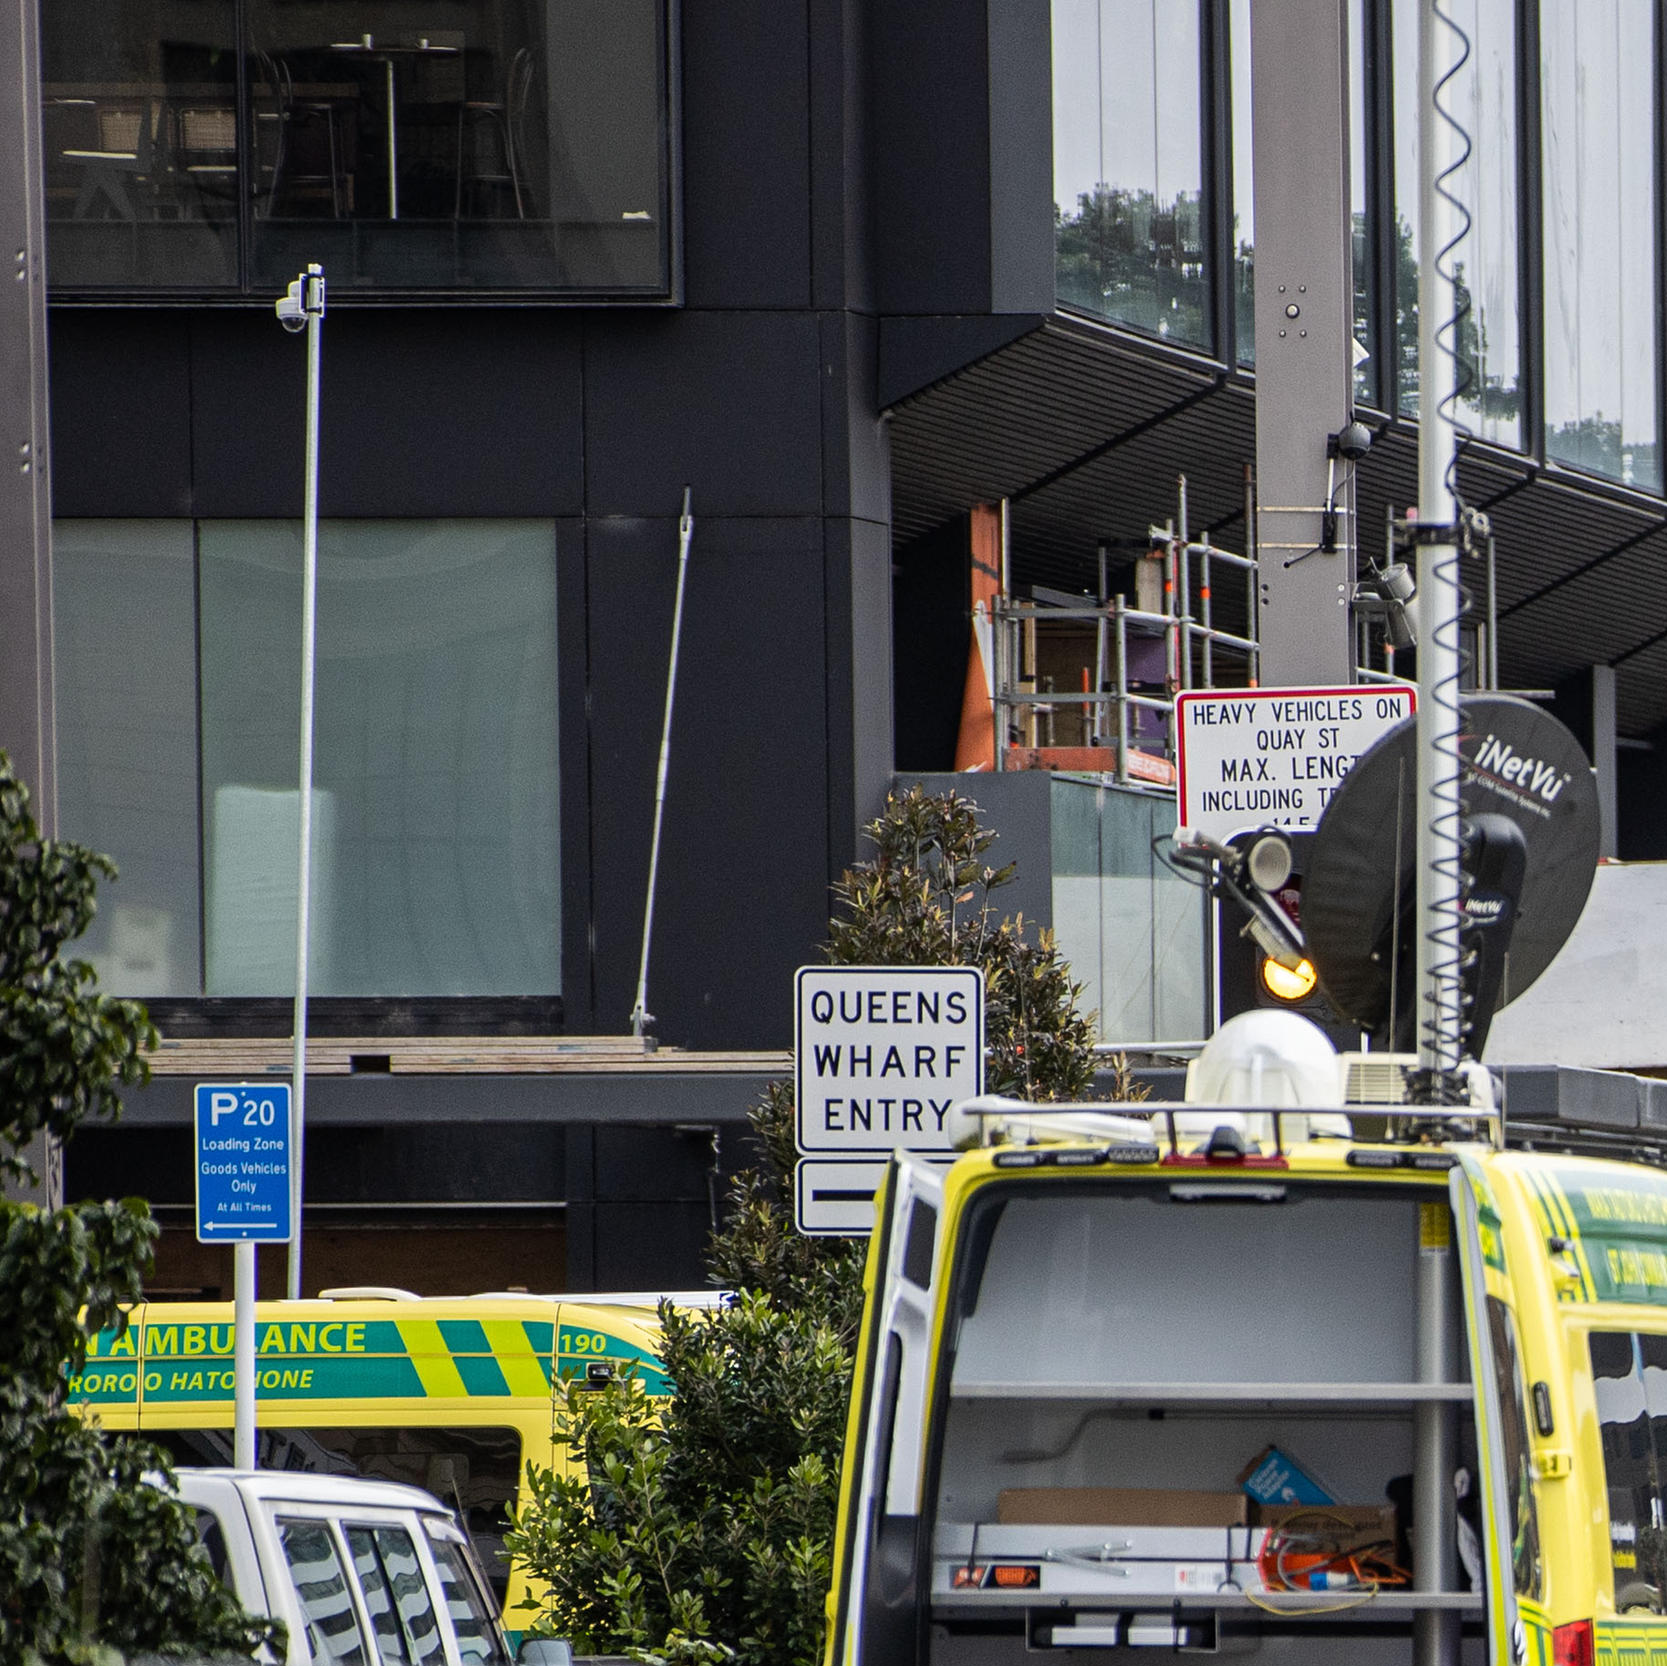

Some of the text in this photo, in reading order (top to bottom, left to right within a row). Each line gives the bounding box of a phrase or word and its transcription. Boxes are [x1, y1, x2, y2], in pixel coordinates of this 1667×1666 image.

[1193, 698, 1401, 725] HEAVY VEHICLES ON
[1256, 728, 1340, 751] QUAY ST
[1221, 755, 1361, 782] MAX. LENGT
[1202, 788, 1304, 812] INCLUDING
[811, 990, 967, 1024] QUEENS
[813, 1044, 966, 1078] WHARF
[824, 1098, 953, 1131] ENTRY
[202, 1137, 284, 1152] Loading Zone
[201, 1162, 287, 1175] Goods Vehicles
[231, 1179, 256, 1194] Only
[217, 1202, 272, 1212] At All Times
[109, 1323, 366, 1357] AMBUANCE
[561, 1334, 607, 1354] 190
